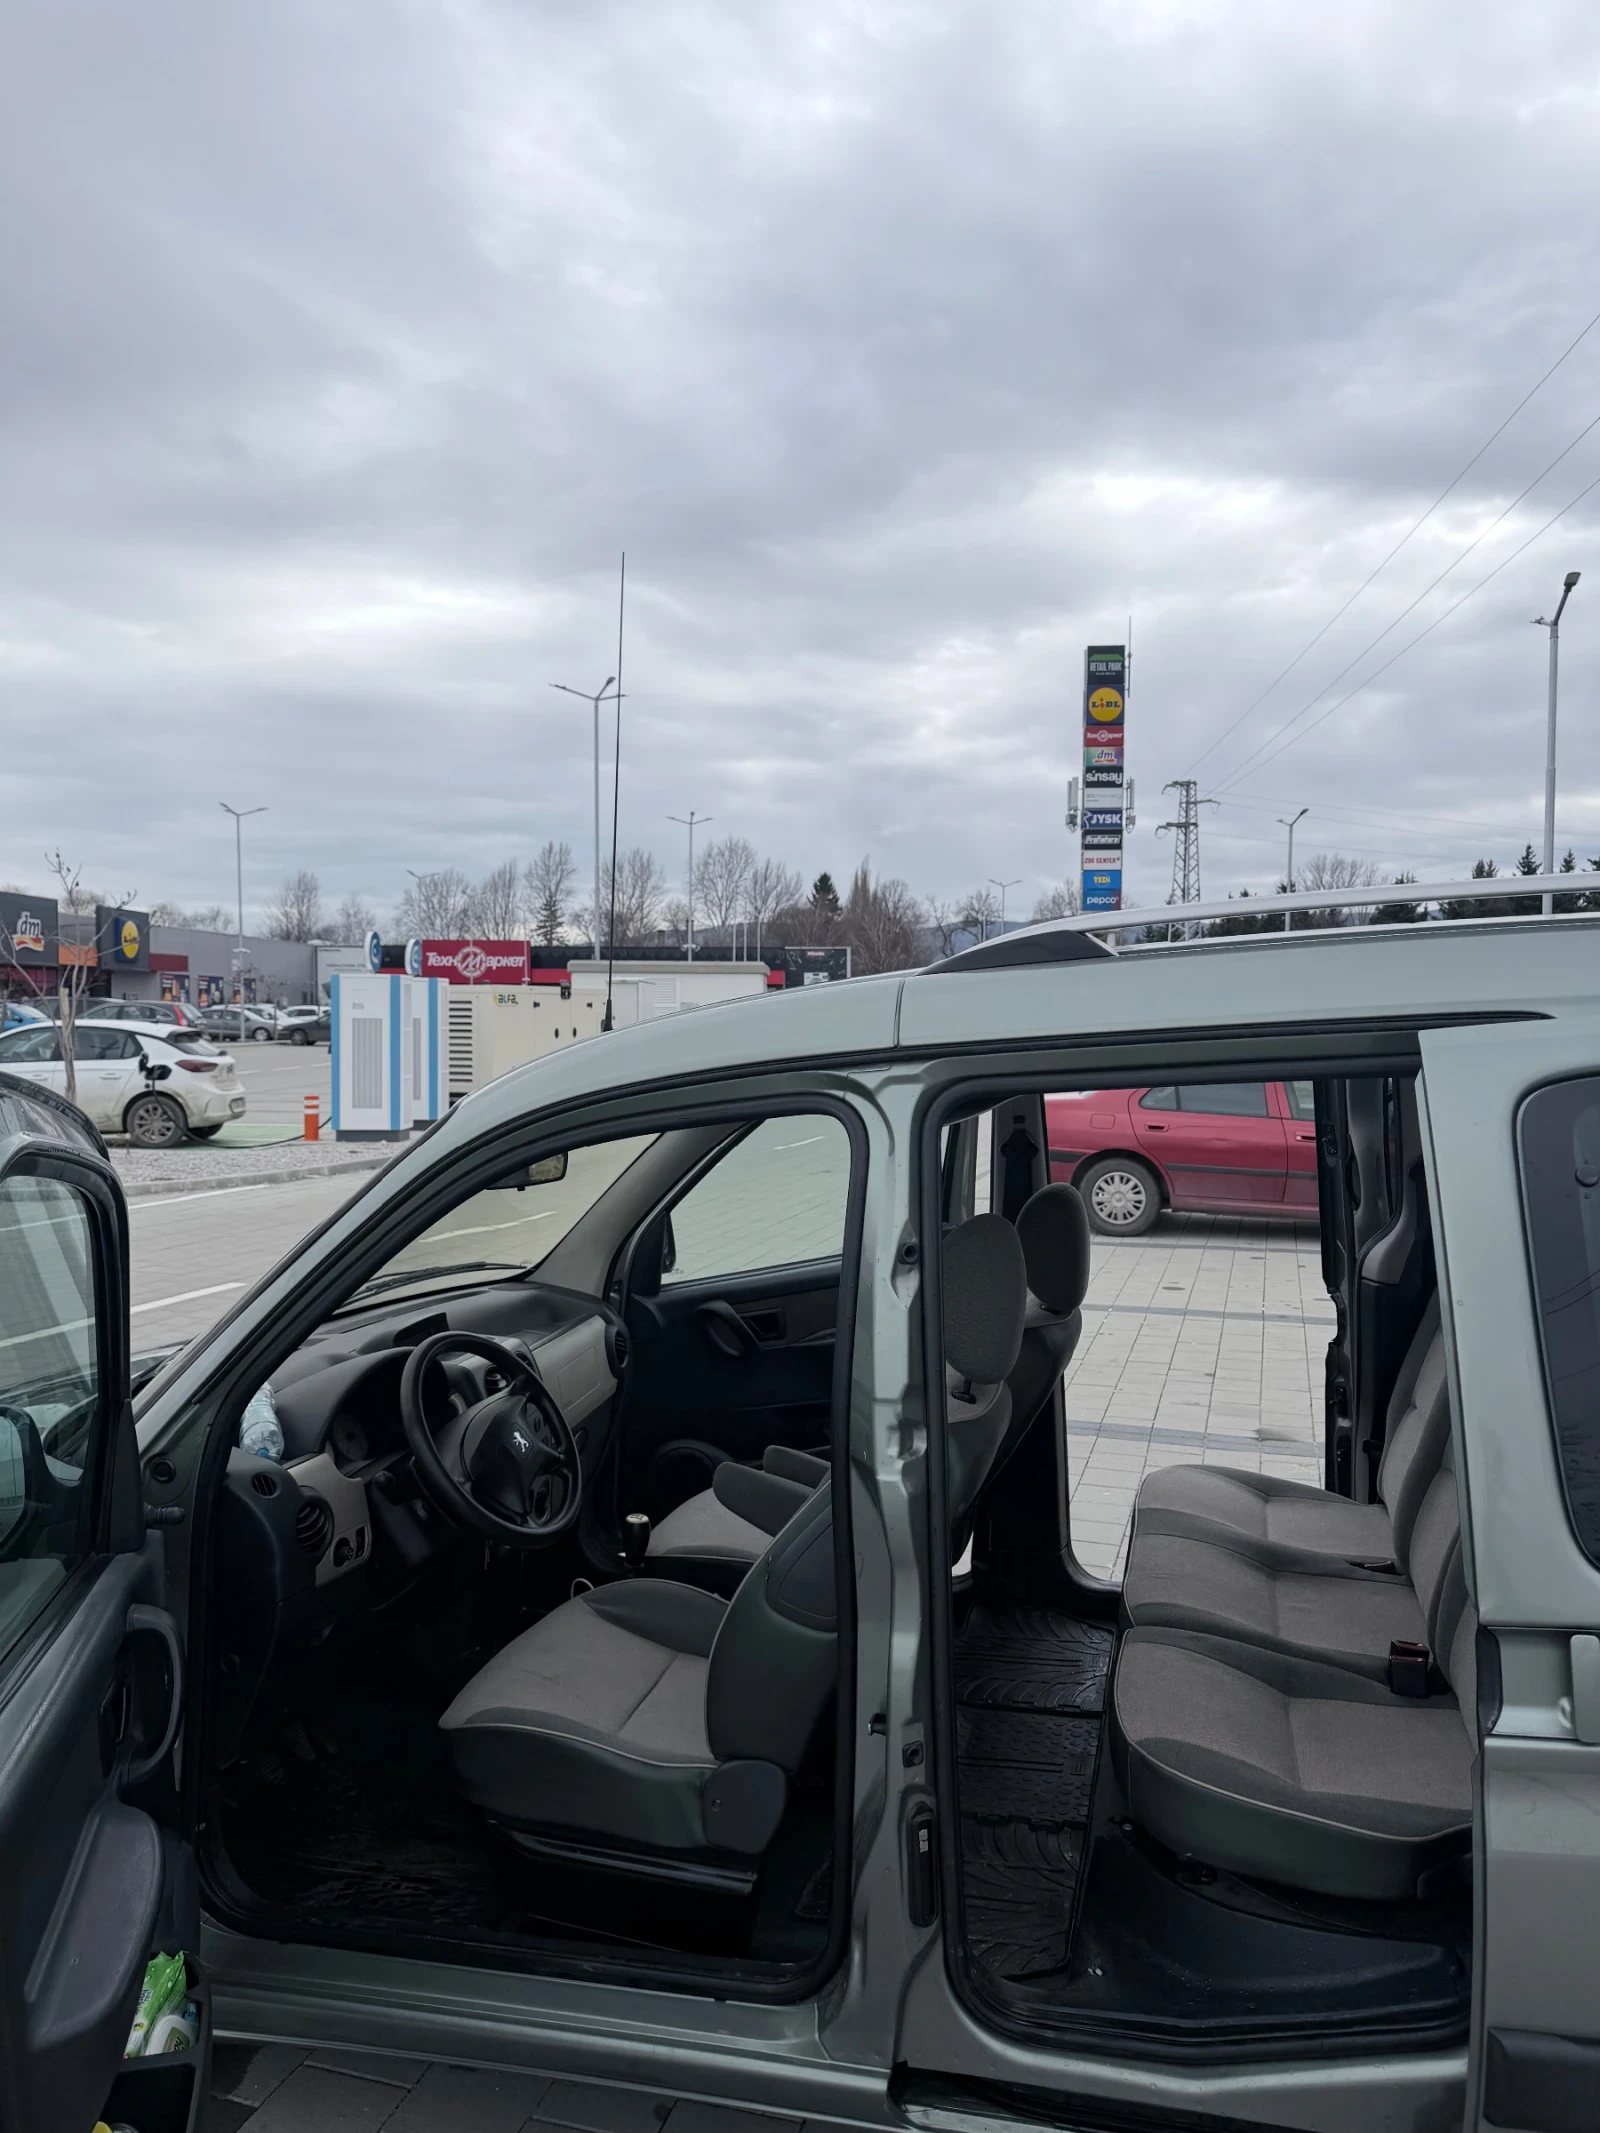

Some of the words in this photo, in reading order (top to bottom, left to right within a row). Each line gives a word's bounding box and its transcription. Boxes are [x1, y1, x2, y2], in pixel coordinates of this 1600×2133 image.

[1108, 661, 1122, 671] PARK
[1097, 749, 1113, 759] dm
[1086, 770, 1123, 784] sinsay
[1090, 813, 1121, 824] JYSK
[20, 914, 40, 937] dm
